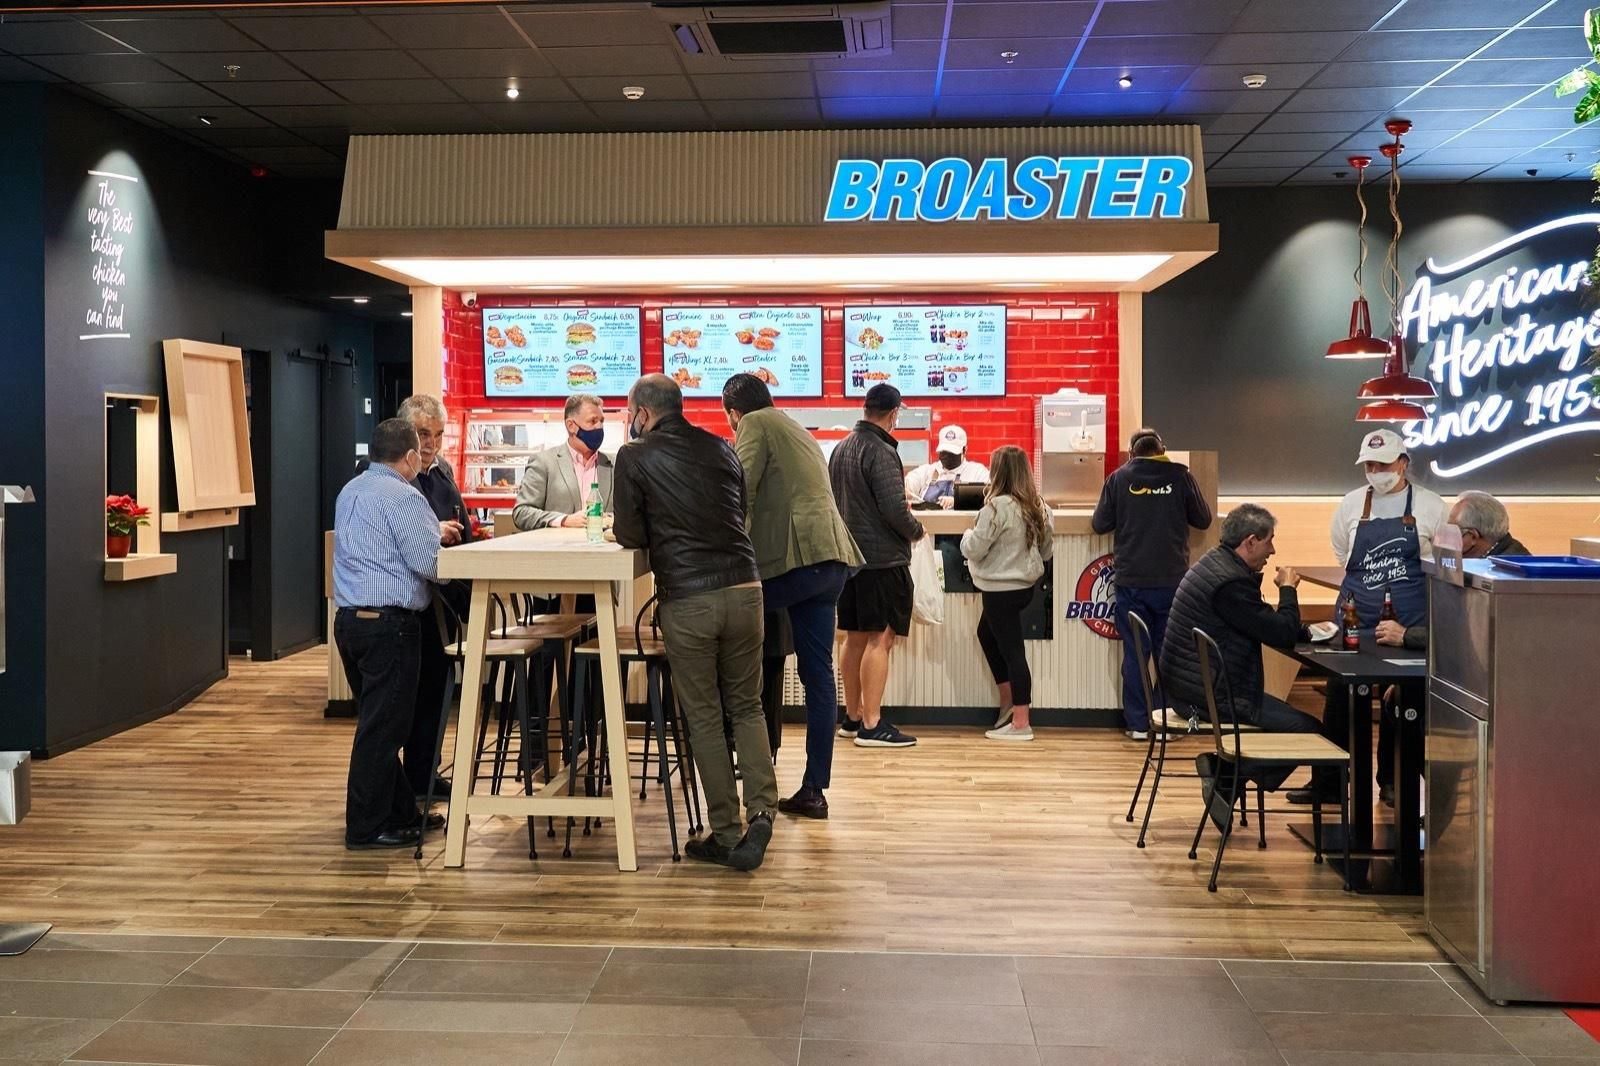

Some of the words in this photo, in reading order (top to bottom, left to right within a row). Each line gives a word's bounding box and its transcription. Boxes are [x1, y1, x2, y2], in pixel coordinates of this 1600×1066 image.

[99, 180, 116, 207] The
[824, 156, 1193, 222] BROASTER
[88, 208, 109, 236] very
[112, 208, 133, 234] Best
[91, 230, 125, 266] tasting
[92, 258, 126, 286] chicken
[102, 286, 118, 313] you
[86, 308, 102, 326] can
[105, 304, 124, 330] find
[1402, 393, 1513, 449] since
[1362, 572, 1384, 583] since
[1388, 565, 1406, 579] 1953
